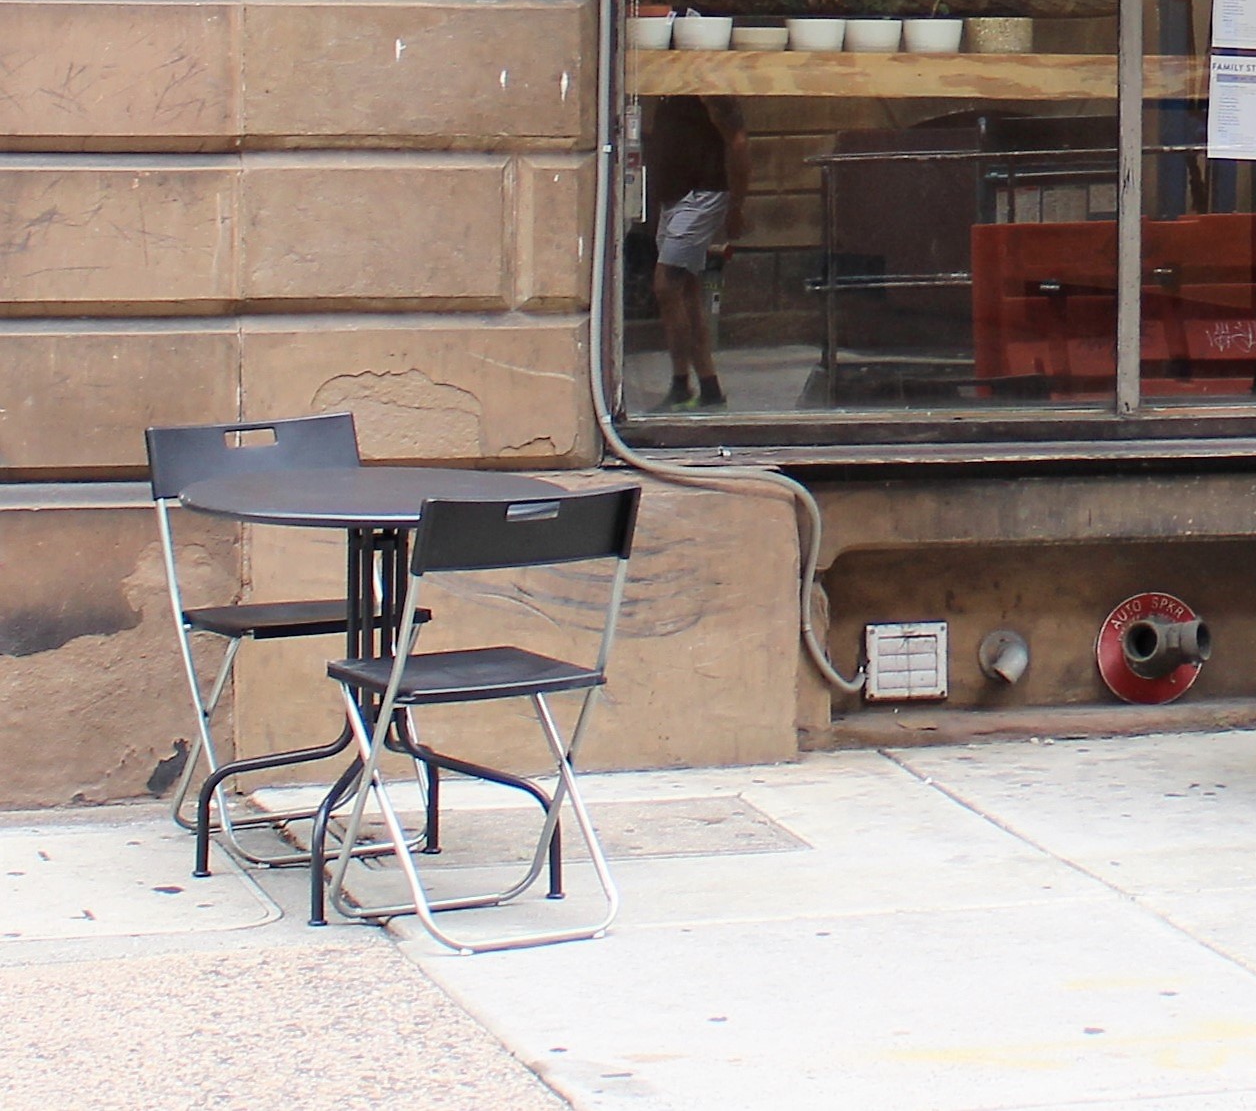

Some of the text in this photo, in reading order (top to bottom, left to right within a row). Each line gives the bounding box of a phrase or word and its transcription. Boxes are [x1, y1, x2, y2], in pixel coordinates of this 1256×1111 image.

[1212, 62, 1243, 72] FAMILY
[1111, 596, 1185, 630] AUTO SPKR
